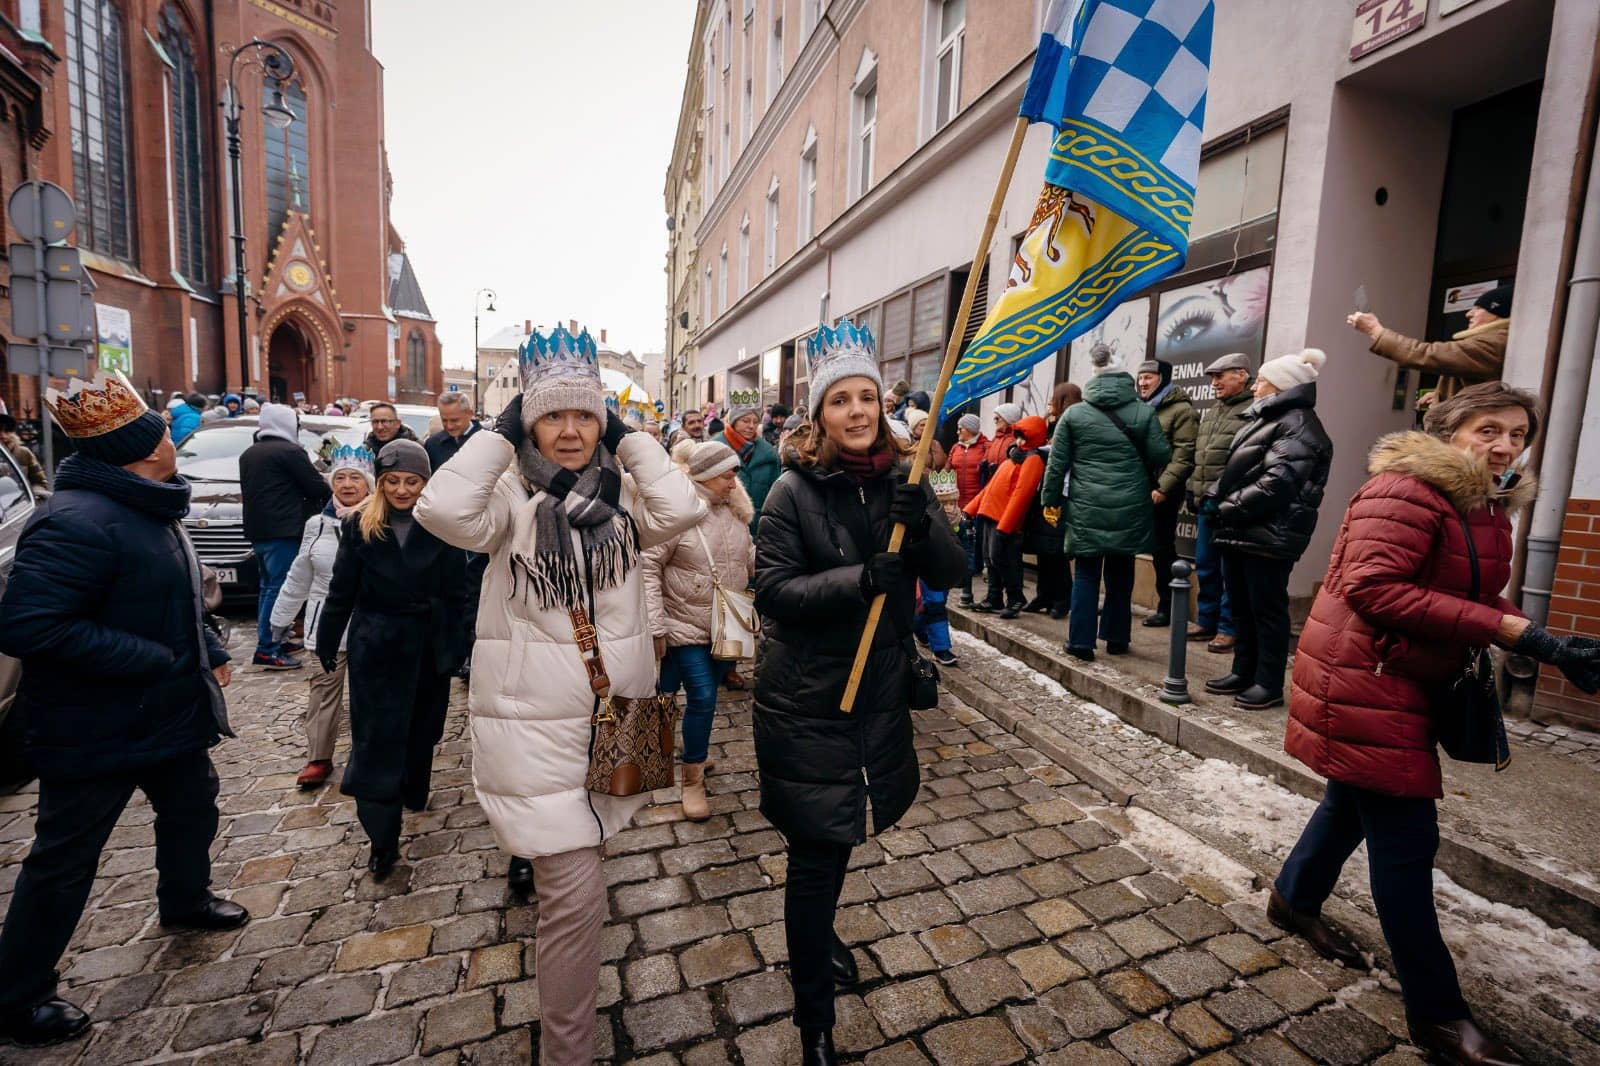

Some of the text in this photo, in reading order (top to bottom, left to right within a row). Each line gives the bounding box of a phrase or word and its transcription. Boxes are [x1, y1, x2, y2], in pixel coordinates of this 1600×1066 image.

[1366, 0, 1414, 35] 14
[1171, 362, 1204, 380] ENNA
[1184, 384, 1216, 401] CURE
